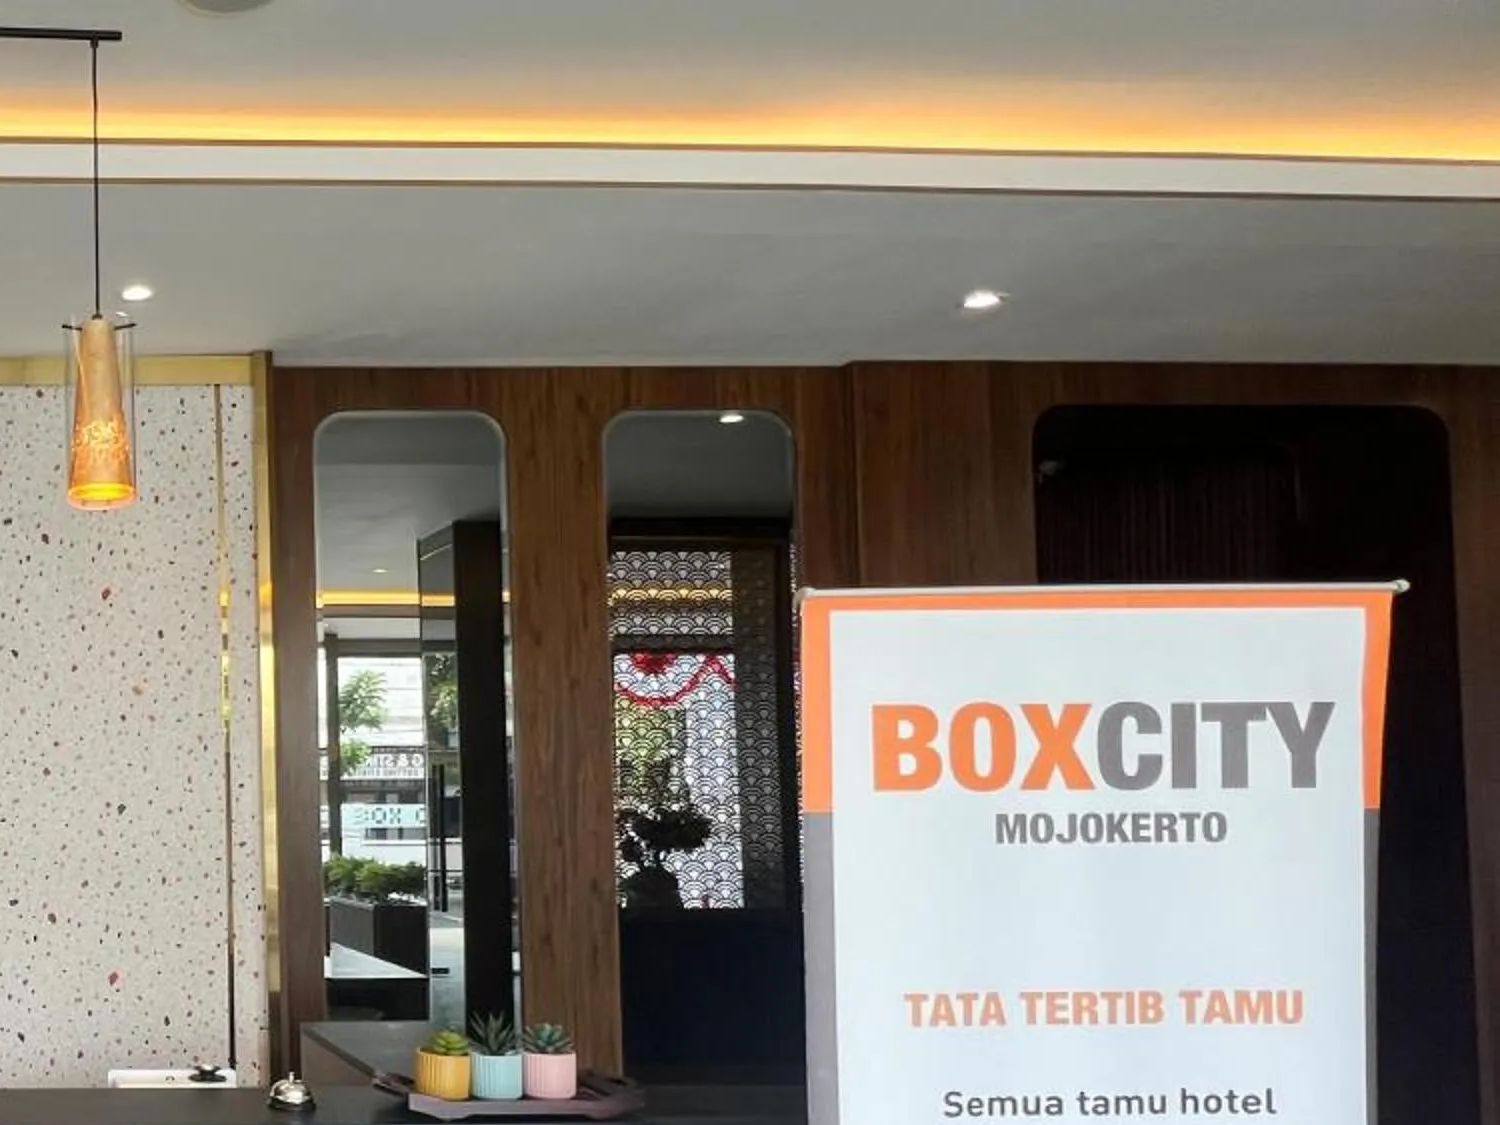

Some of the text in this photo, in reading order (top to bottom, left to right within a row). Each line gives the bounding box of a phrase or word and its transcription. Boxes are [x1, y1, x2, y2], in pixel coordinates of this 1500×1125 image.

[871, 700, 1337, 793] BOXCITY
[995, 811, 1228, 845] MOJOKERTO
[903, 989, 1304, 1028] TATA TERTIB TAMU
[943, 1087, 1277, 1119] Semua tamu hotel
